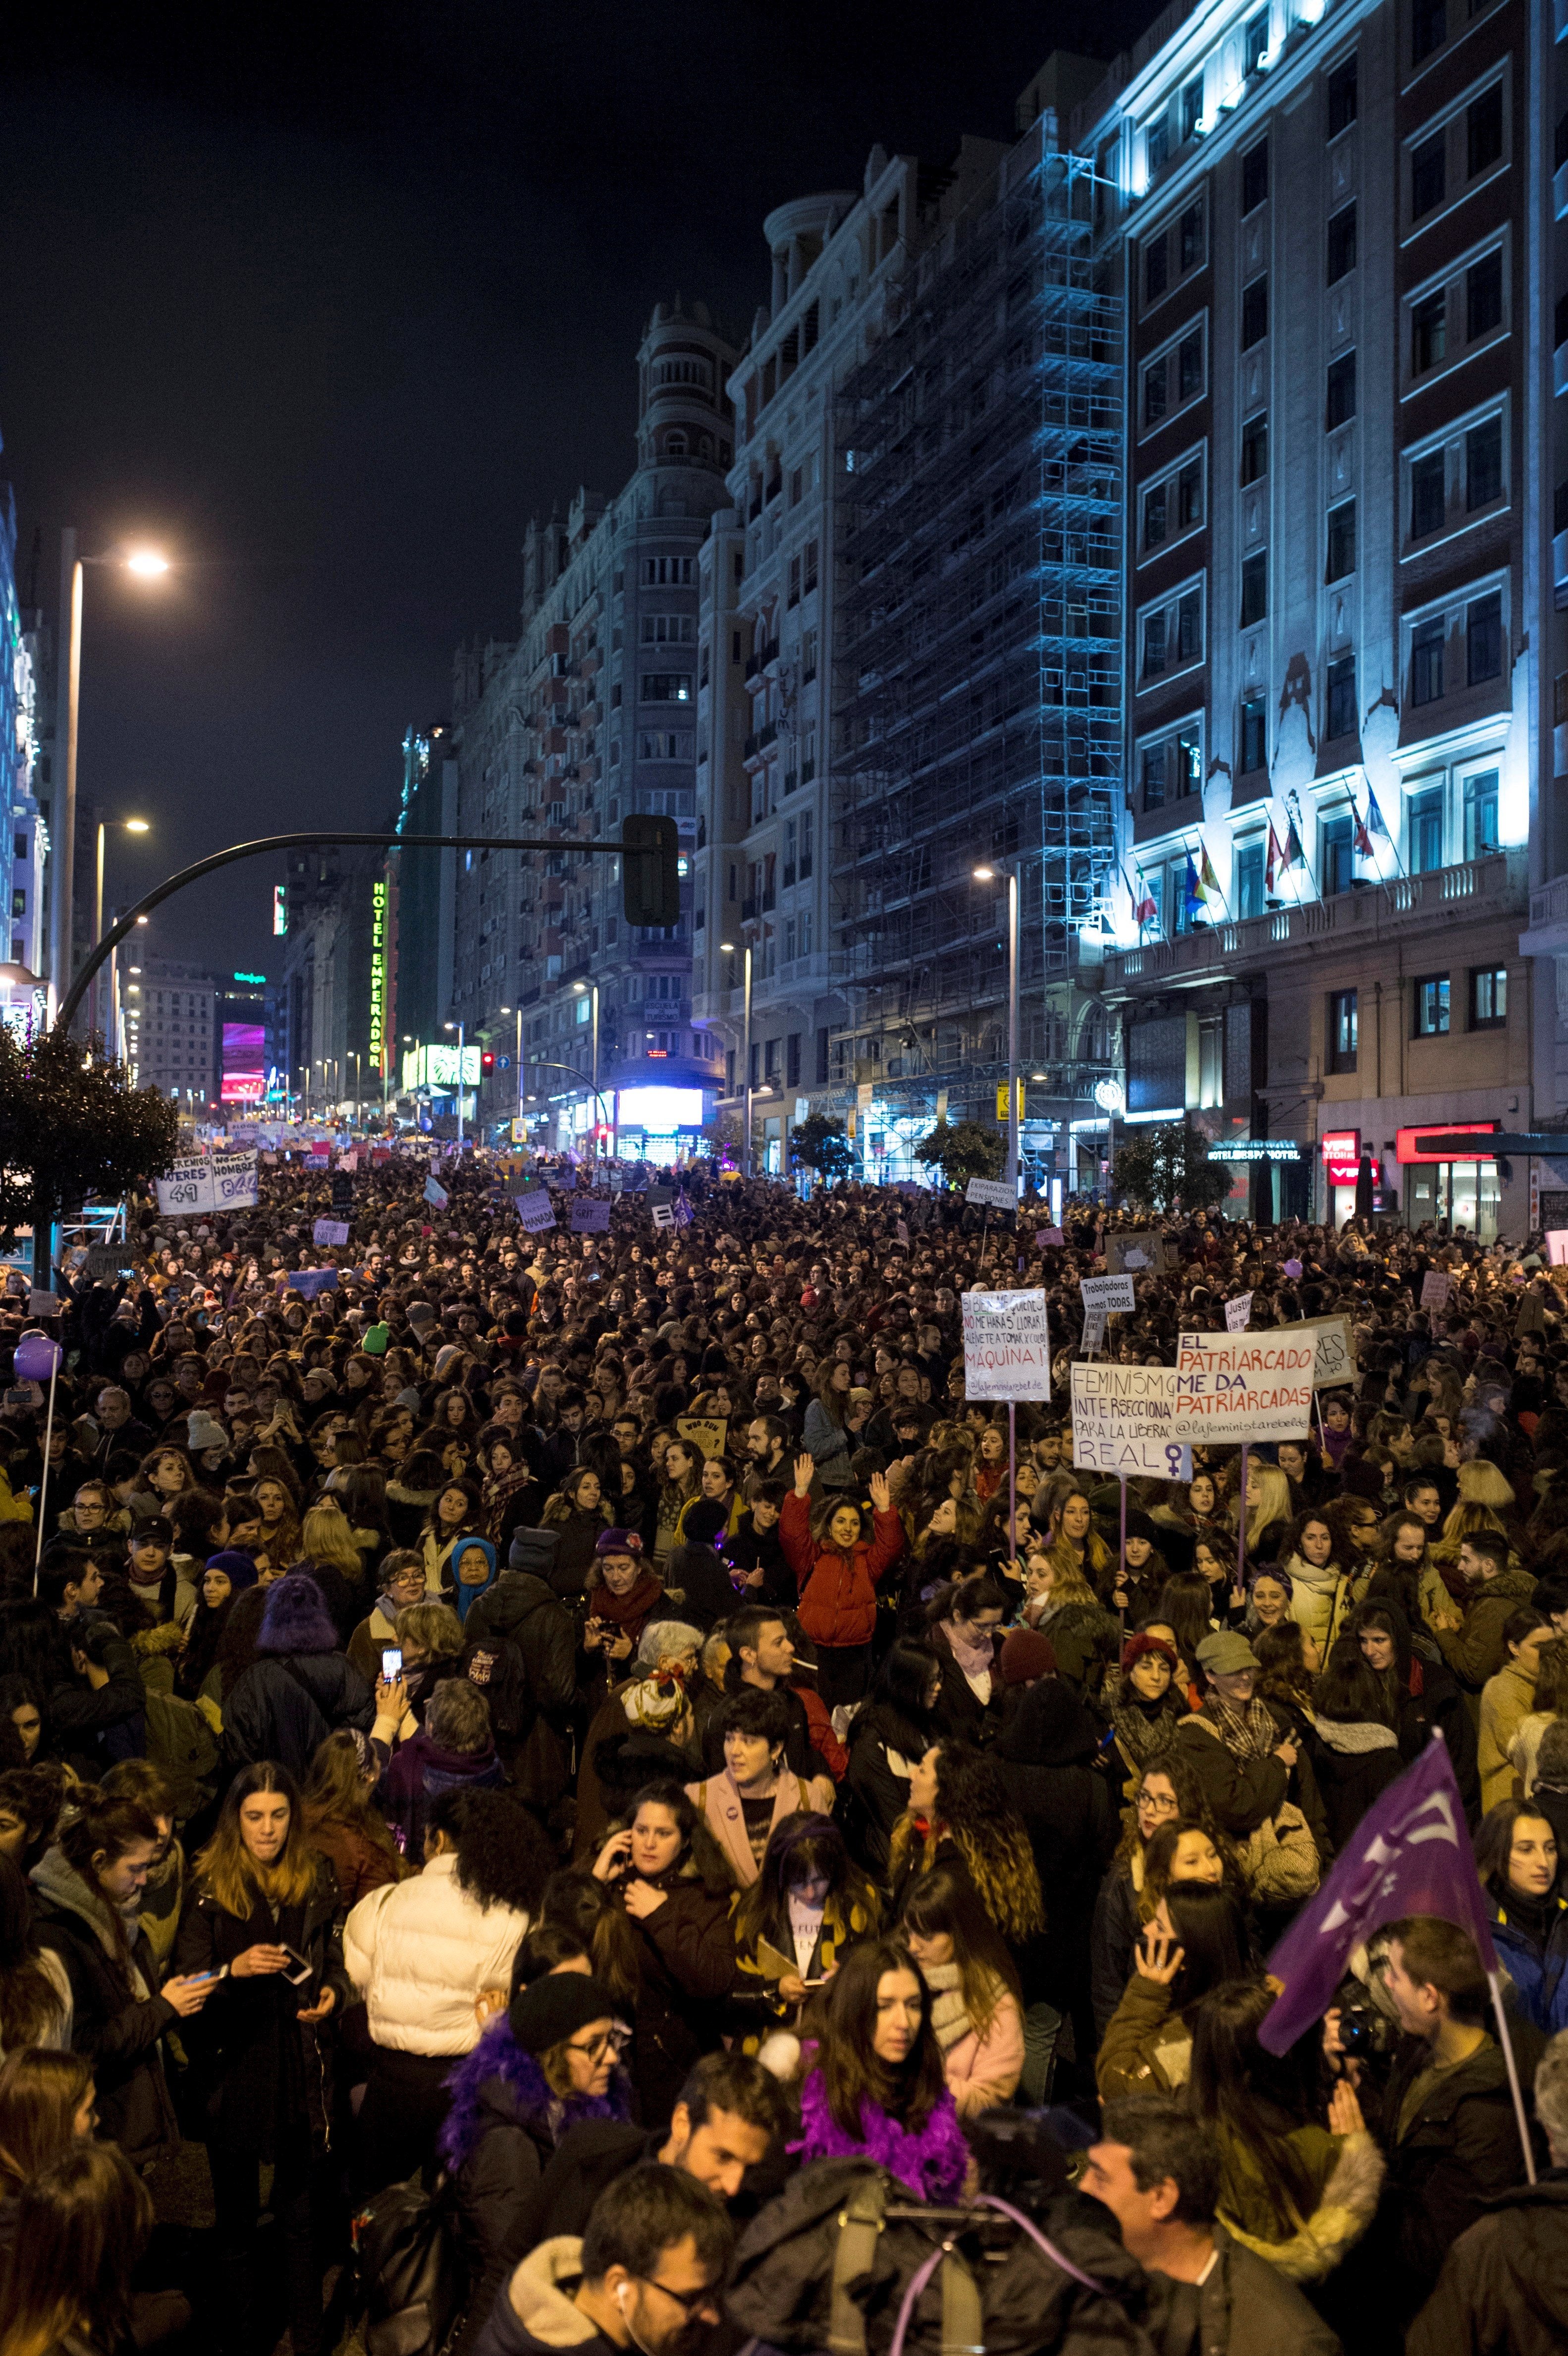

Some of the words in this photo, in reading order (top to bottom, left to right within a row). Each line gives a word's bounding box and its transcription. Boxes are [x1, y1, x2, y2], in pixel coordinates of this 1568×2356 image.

[373, 883, 385, 947] HOTEL
[369, 953, 383, 1067] EMPERADOR
[170, 1183, 198, 1203] 49
[971, 1182, 1016, 1195] EKIPARAZION
[970, 1192, 1009, 1205] PENSIONES
[524, 1210, 556, 1229] MANADA
[1083, 1280, 1129, 1295] Trabajadoras
[1087, 1300, 1106, 1310] somos
[1106, 1296, 1133, 1308] TODAS.
[964, 1315, 974, 1329] NO
[975, 1315, 986, 1329] ME
[1016, 1315, 1045, 1331] LLORAR!
[995, 1333, 1001, 1343] A
[1001, 1332, 1024, 1344] TOMAR
[1024, 1333, 1029, 1344] X
[1181, 1335, 1208, 1349] EL
[1179, 1346, 1312, 1372] PATRIARCADO
[1177, 1374, 1207, 1394] ME
[1215, 1373, 1247, 1391] DA
[1176, 1386, 1311, 1415] PATRIARCADAS
[685, 1420, 702, 1431] WHO
[703, 1420, 720, 1432] RUN
[691, 1430, 710, 1438] THE
[1075, 1419, 1106, 1439] PARA
[1110, 1424, 1126, 1439] LA
[1176, 1417, 1308, 1438] @lafeministarebelde
[1078, 1440, 1160, 1468] REAL
